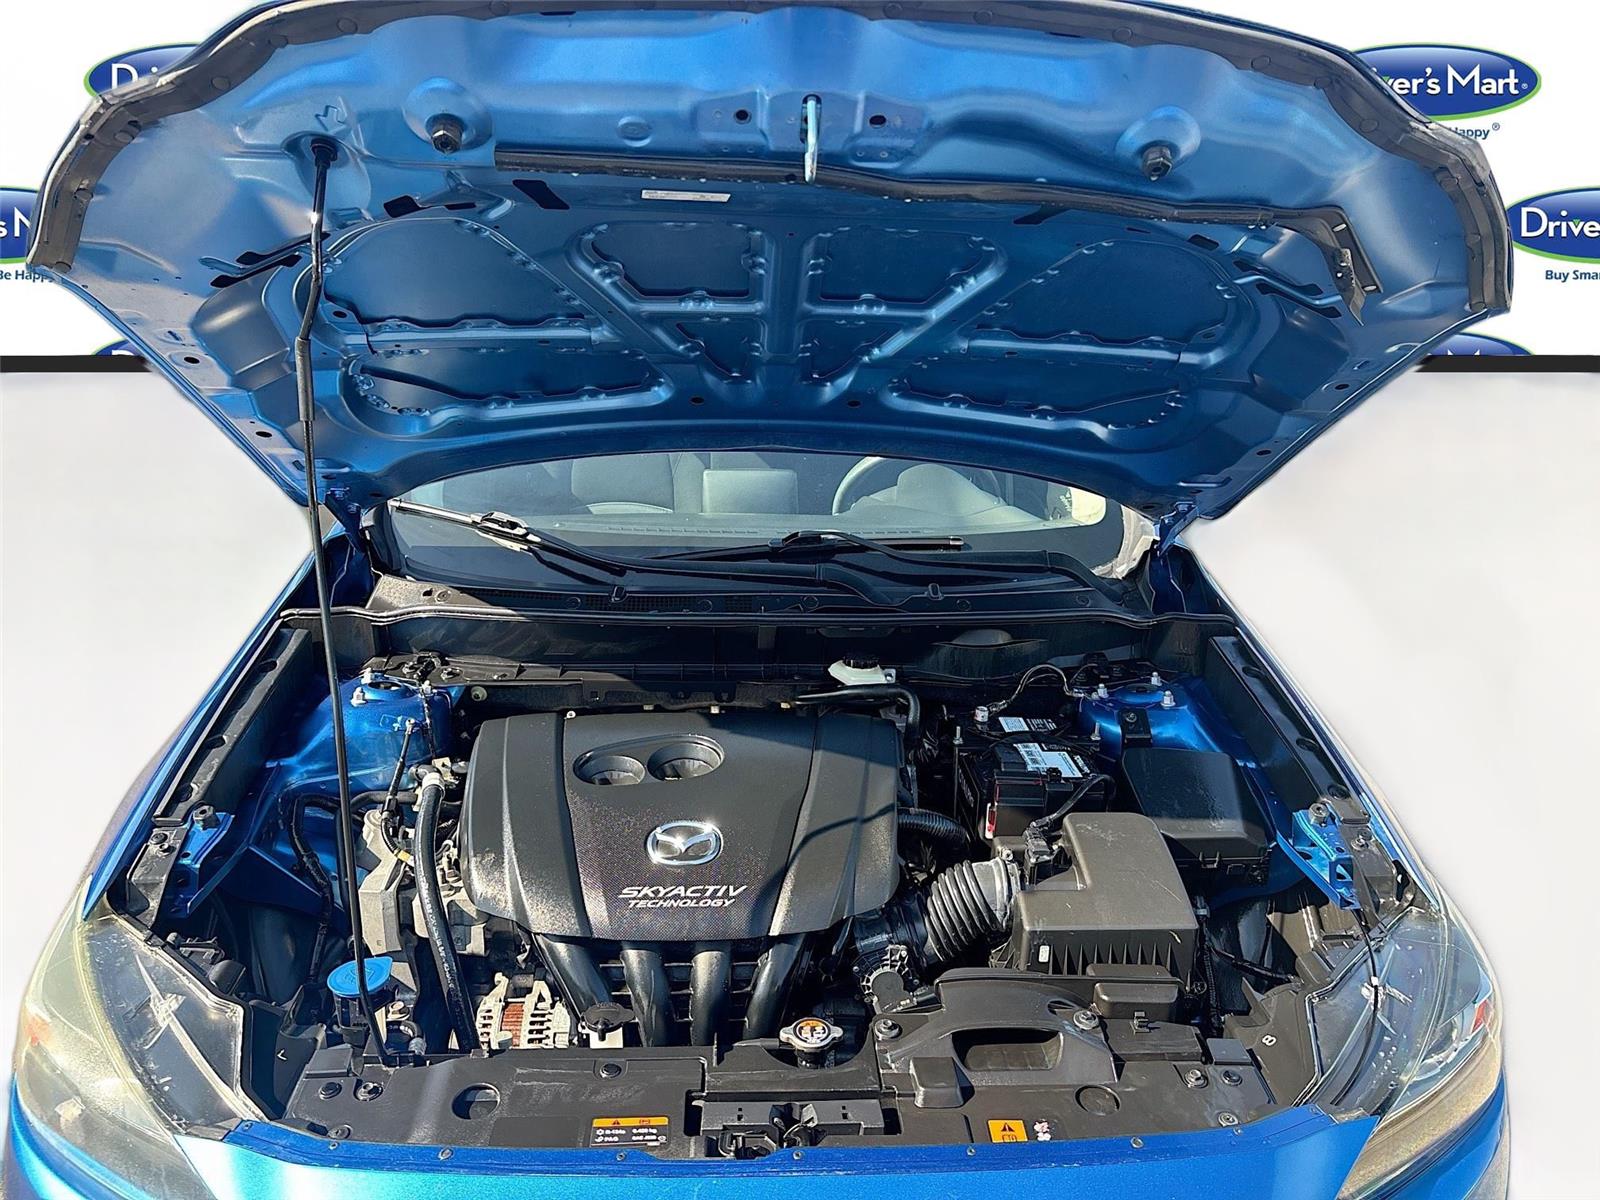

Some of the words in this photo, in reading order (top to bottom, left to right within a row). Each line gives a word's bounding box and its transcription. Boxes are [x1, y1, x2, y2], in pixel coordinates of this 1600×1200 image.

[1447, 64, 1519, 95] Mart
[1451, 127, 1490, 140] appy
[1545, 269, 1570, 283] Buy
[1572, 269, 1600, 281] Sma
[618, 885, 748, 899] SKYACTIV
[628, 898, 736, 909] TECHNOLOGY
